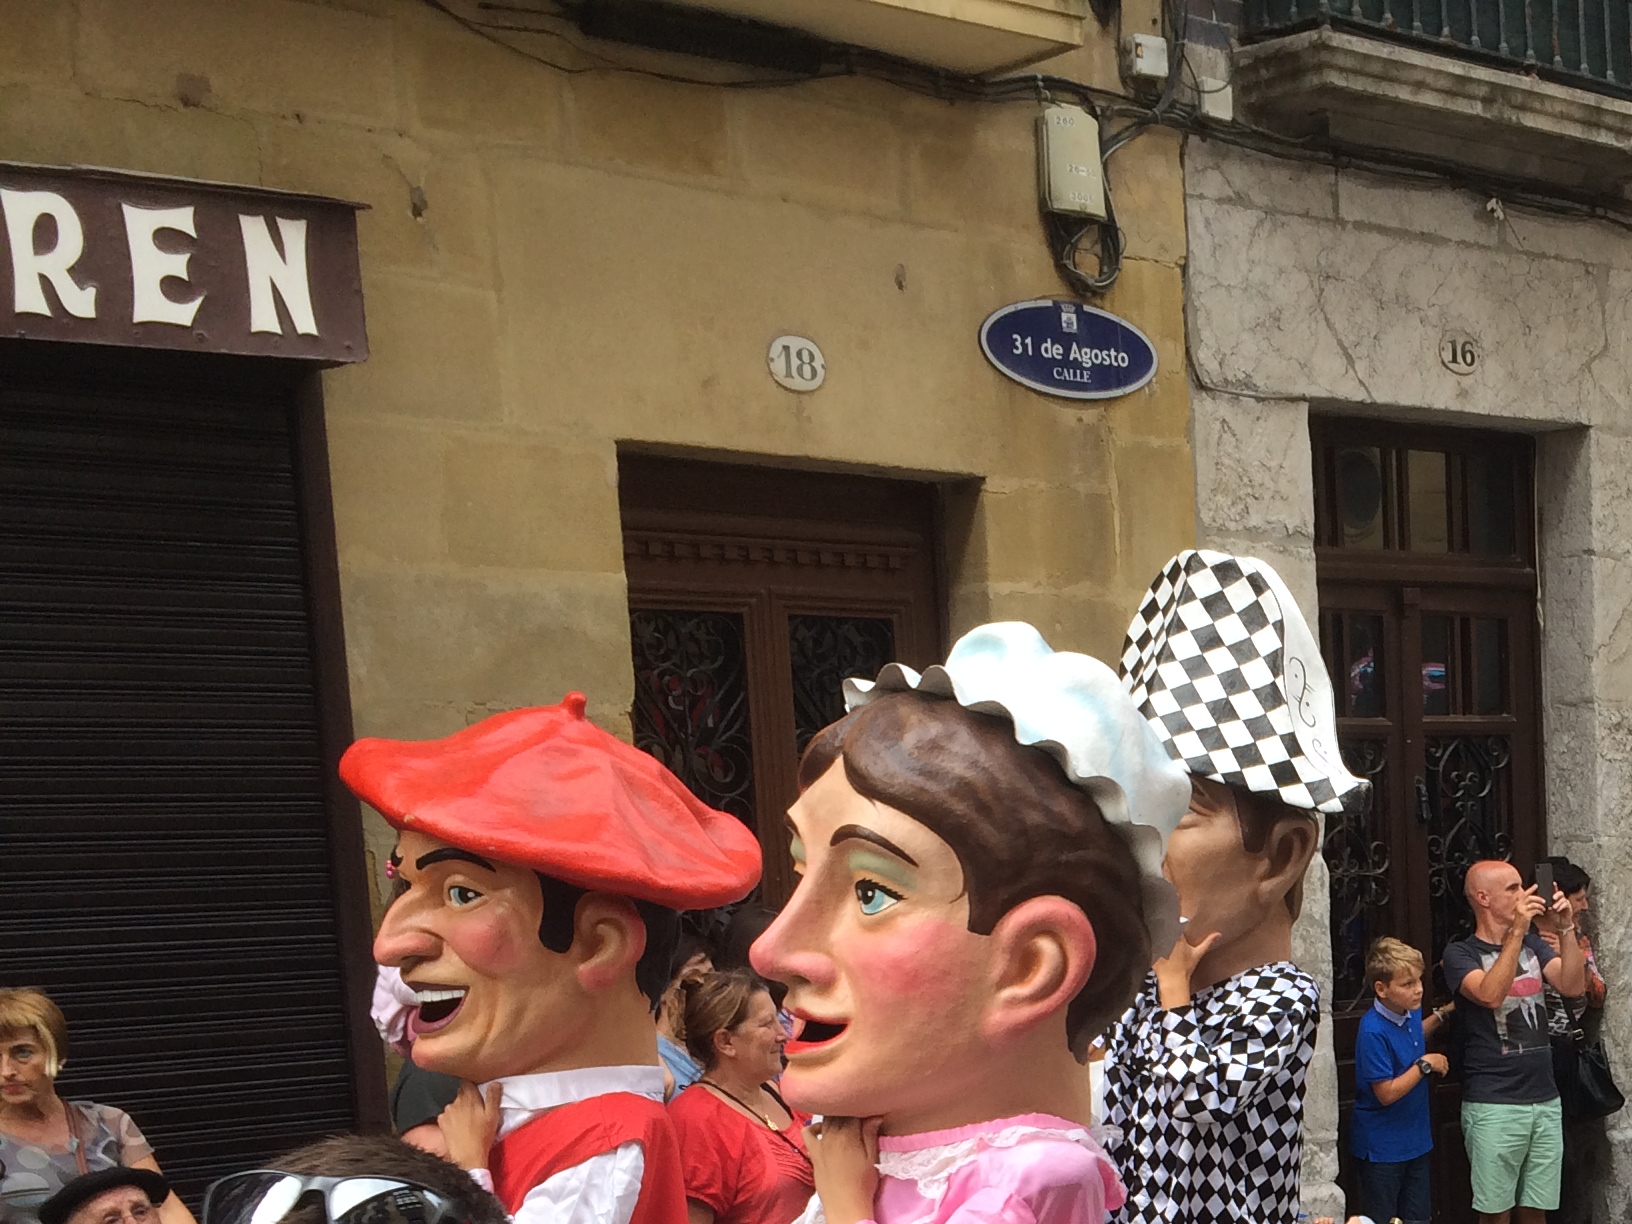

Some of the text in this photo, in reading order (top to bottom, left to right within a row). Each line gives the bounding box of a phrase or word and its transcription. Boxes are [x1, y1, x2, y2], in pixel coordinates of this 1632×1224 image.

[0, 188, 320, 337] REN
[777, 345, 818, 382] 18
[1012, 334, 1129, 368] 31 de Agosto
[1447, 339, 1476, 367] 16
[1053, 366, 1092, 383] CALLE
